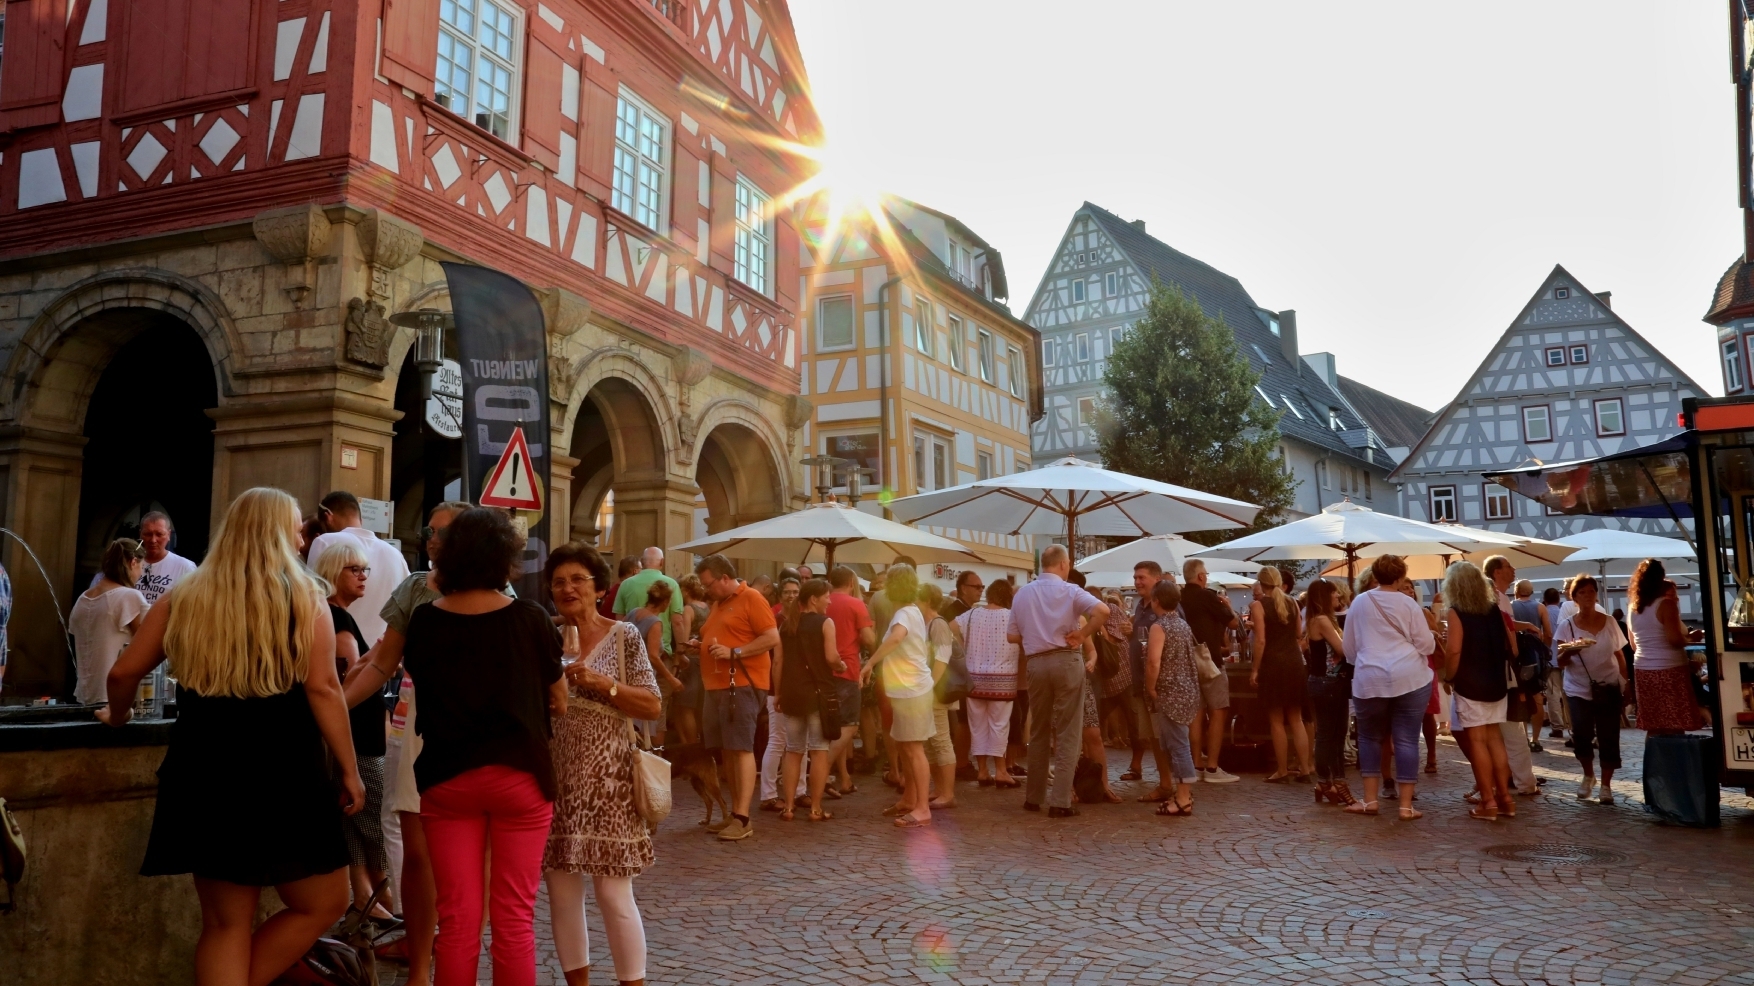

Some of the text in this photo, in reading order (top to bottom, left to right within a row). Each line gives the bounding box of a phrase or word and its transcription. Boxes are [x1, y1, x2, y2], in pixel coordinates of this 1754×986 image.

[440, 367, 462, 387] Altes
[134, 583, 166, 594] DONDO
[134, 707, 155, 715] inger
